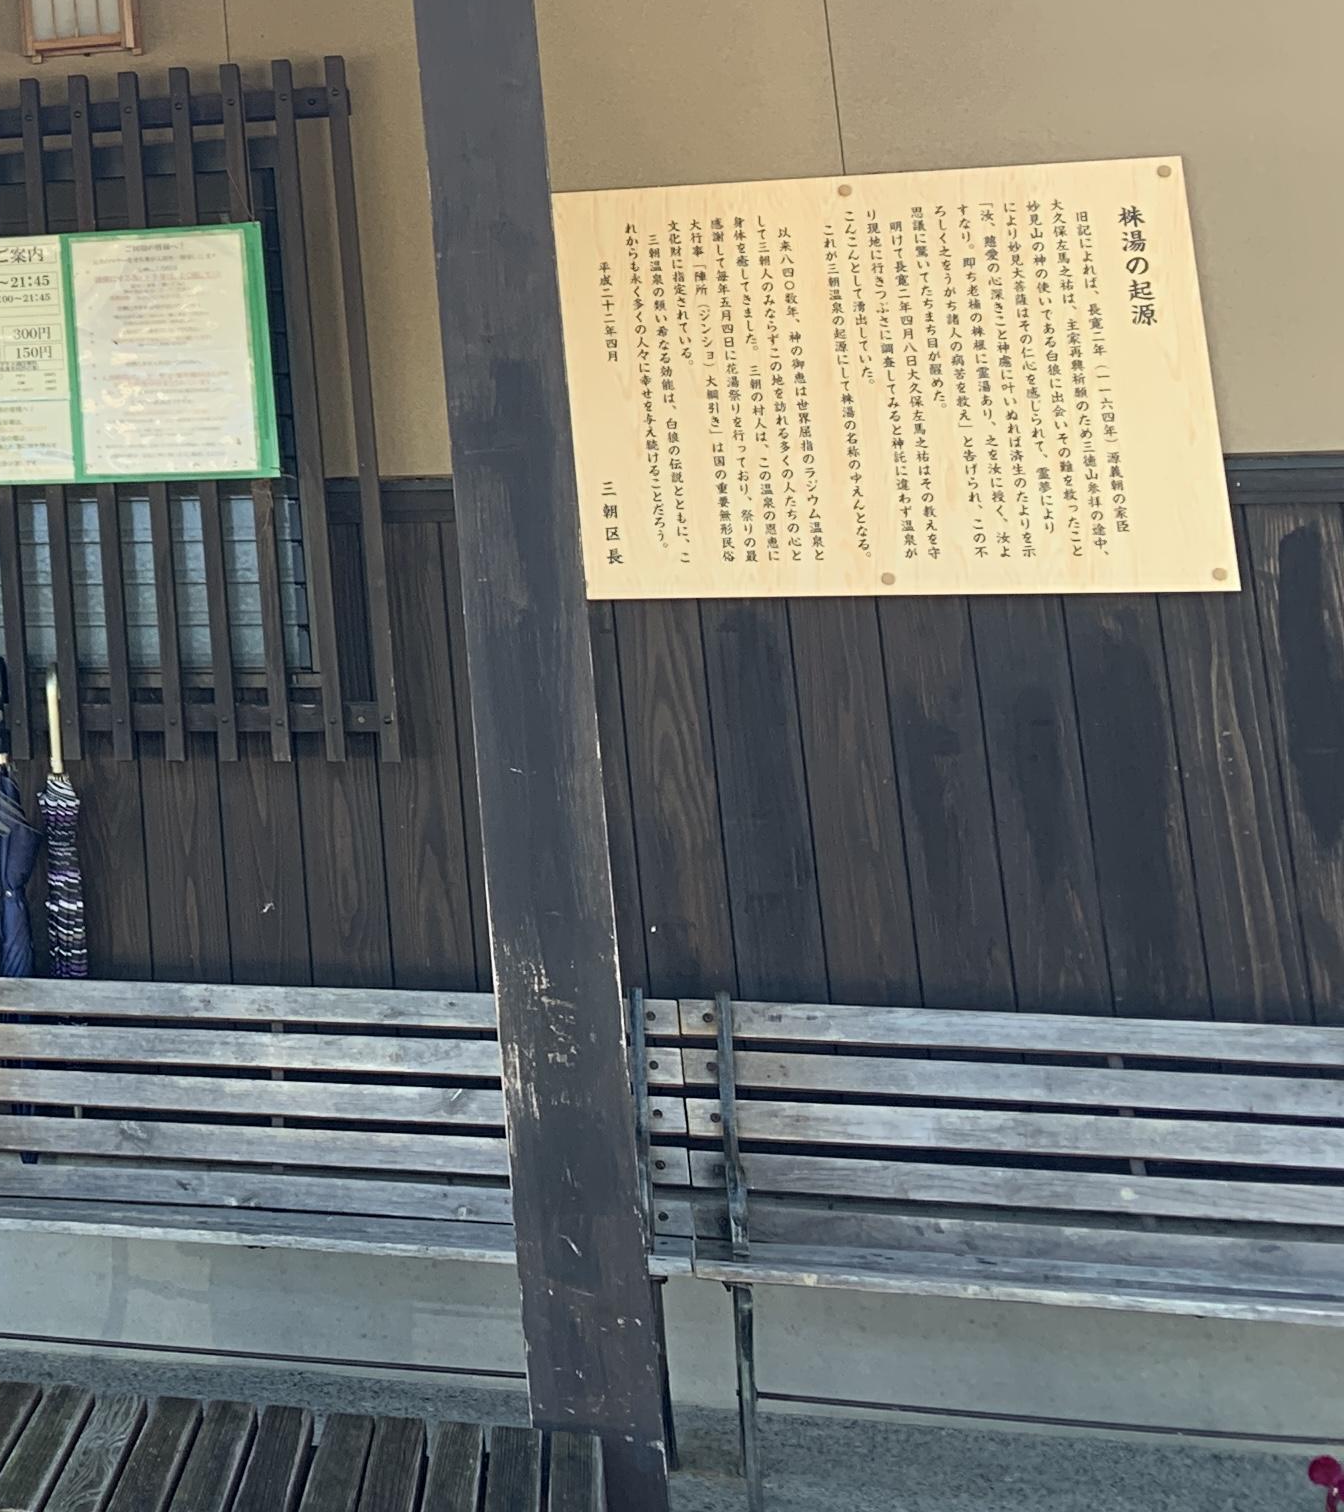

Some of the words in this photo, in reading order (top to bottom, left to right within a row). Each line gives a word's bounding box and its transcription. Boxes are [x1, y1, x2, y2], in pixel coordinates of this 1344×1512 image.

[1116, 204, 1158, 326] 株湯の起源
[14, 326, 51, 340] 300円
[16, 345, 52, 359] 150円
[597, 261, 619, 361] 平成二十二年四月
[600, 480, 623, 564] 三朝区長
